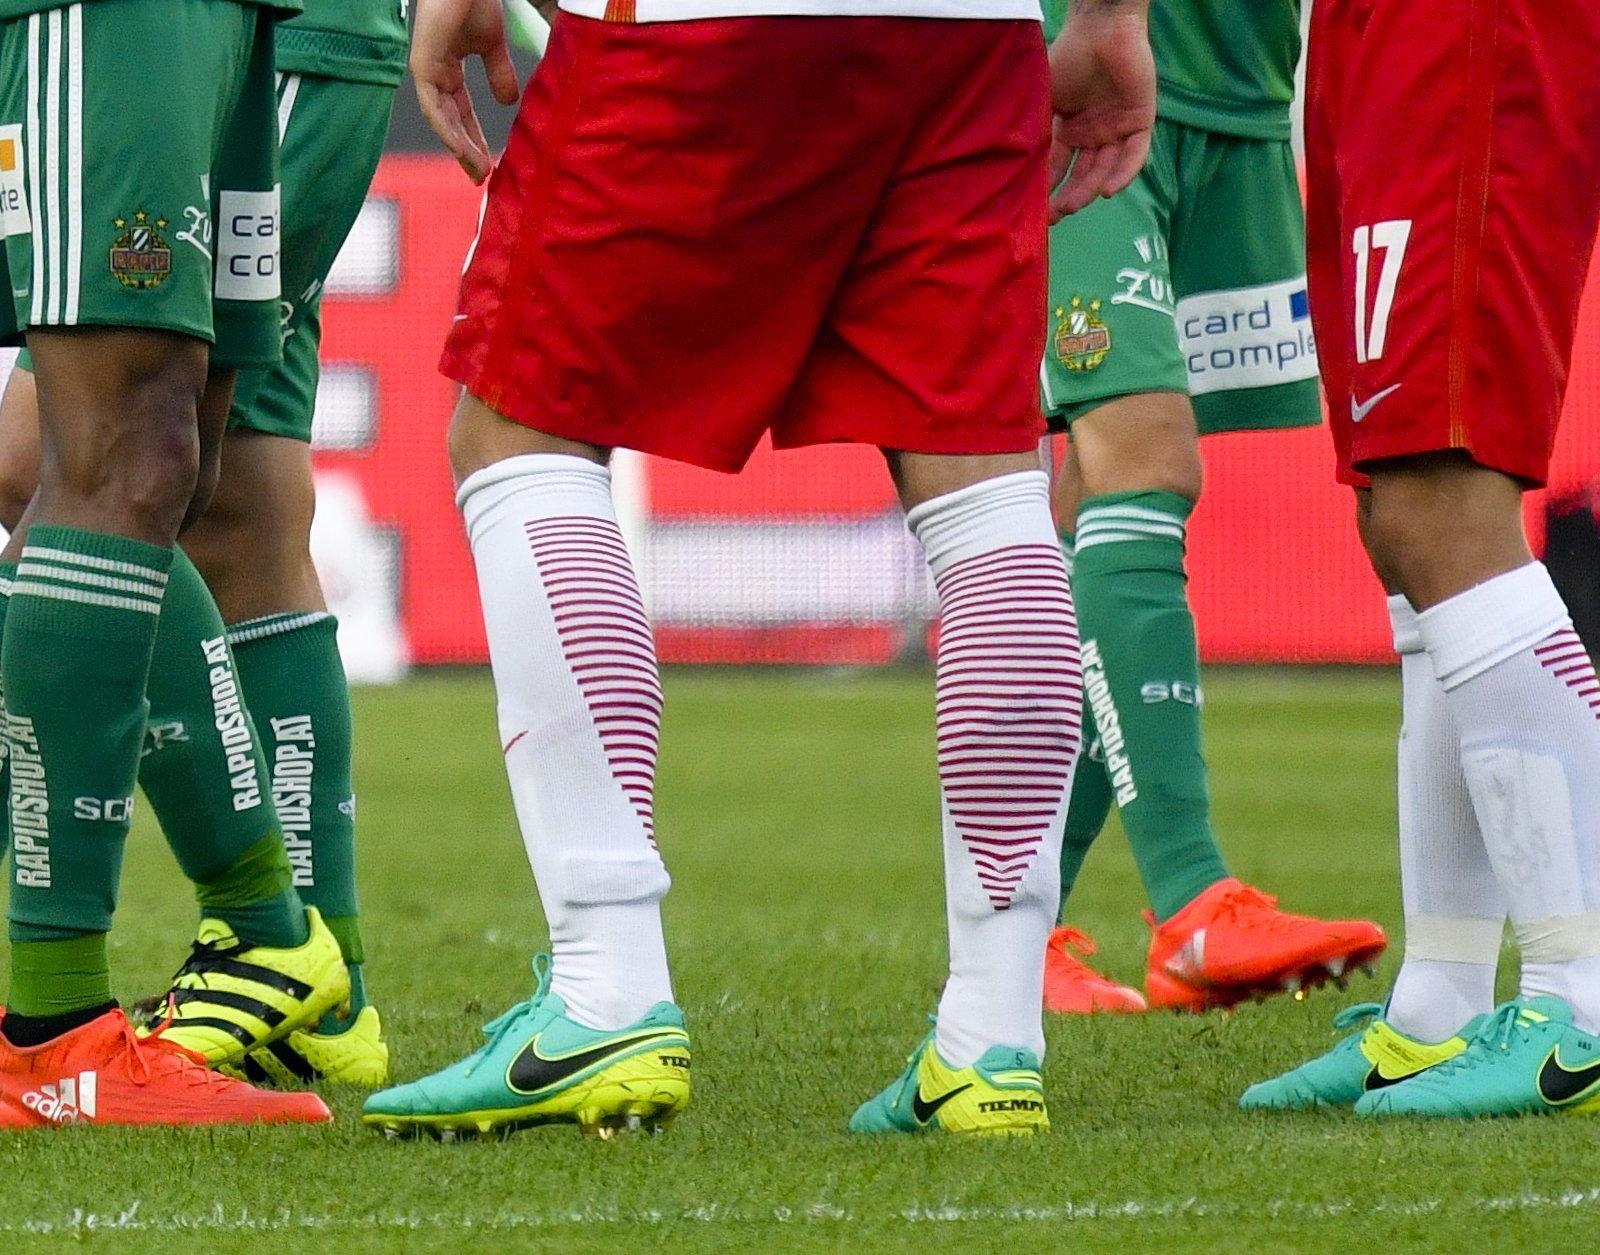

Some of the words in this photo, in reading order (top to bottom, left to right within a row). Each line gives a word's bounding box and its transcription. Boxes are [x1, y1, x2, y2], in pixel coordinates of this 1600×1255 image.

[1184, 300, 1271, 339] card
[1352, 219, 1413, 364] 17
[201, 634, 261, 812] RAPIDSHOP.AT
